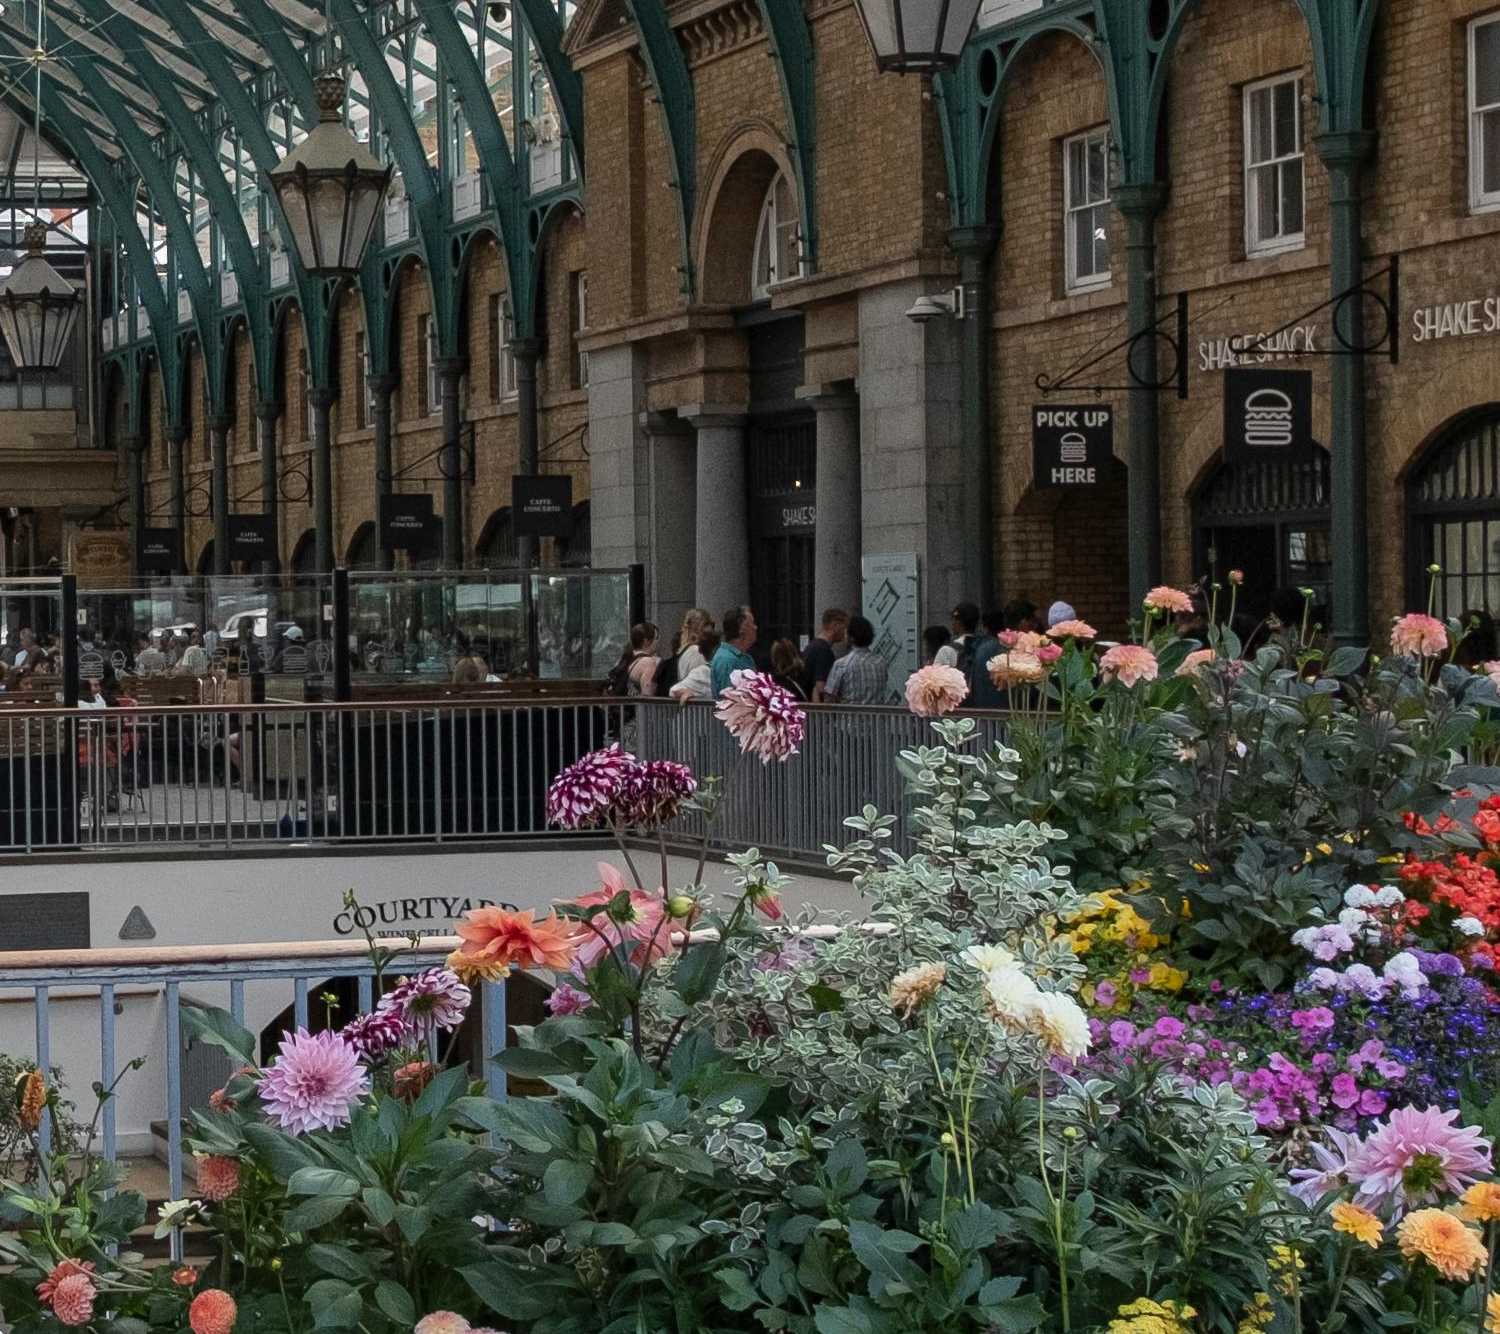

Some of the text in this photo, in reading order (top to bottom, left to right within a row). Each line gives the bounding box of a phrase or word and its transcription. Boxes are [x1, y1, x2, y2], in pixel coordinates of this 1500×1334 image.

[1411, 304, 1480, 342] SHAKE
[1037, 411, 1109, 427] PICK UP
[1051, 468, 1096, 484] HERE
[782, 506, 808, 527] SHAKE
